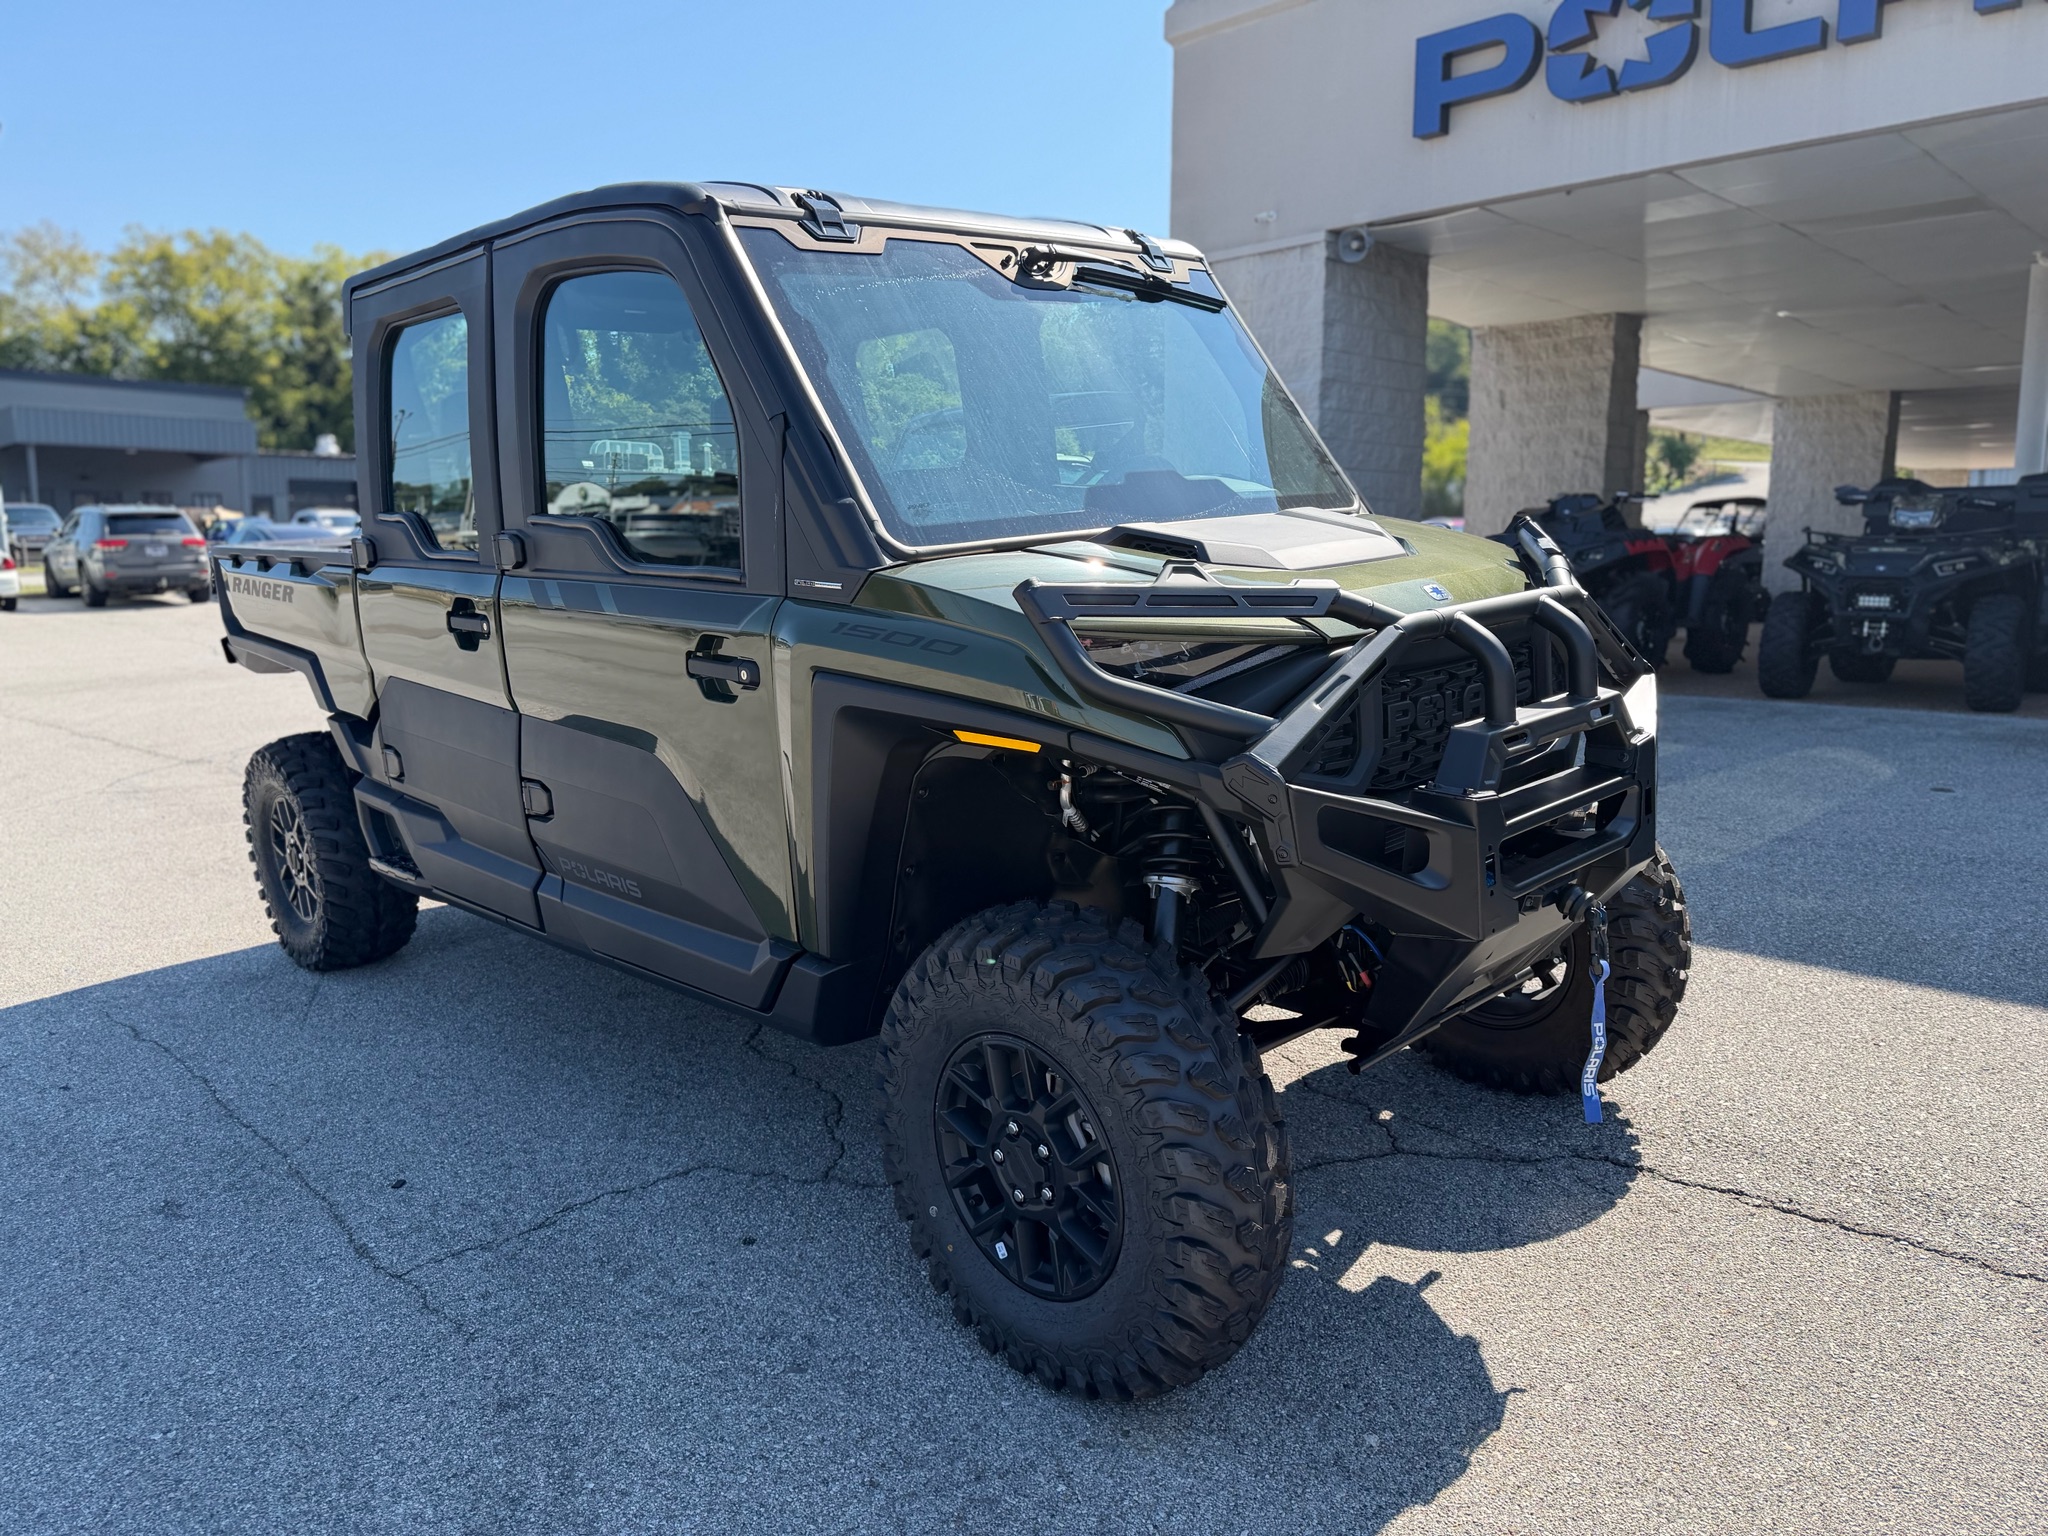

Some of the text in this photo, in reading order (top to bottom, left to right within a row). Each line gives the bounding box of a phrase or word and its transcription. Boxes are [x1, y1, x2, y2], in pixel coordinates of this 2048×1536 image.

[1412, 0, 2023, 139] POL
[232, 576, 295, 604] RANGER
[829, 621, 969, 656] 1500
[1387, 665, 1534, 740] POLAS
[558, 856, 642, 898] POLARIS
[1583, 1022, 1605, 1097] POLARIS
